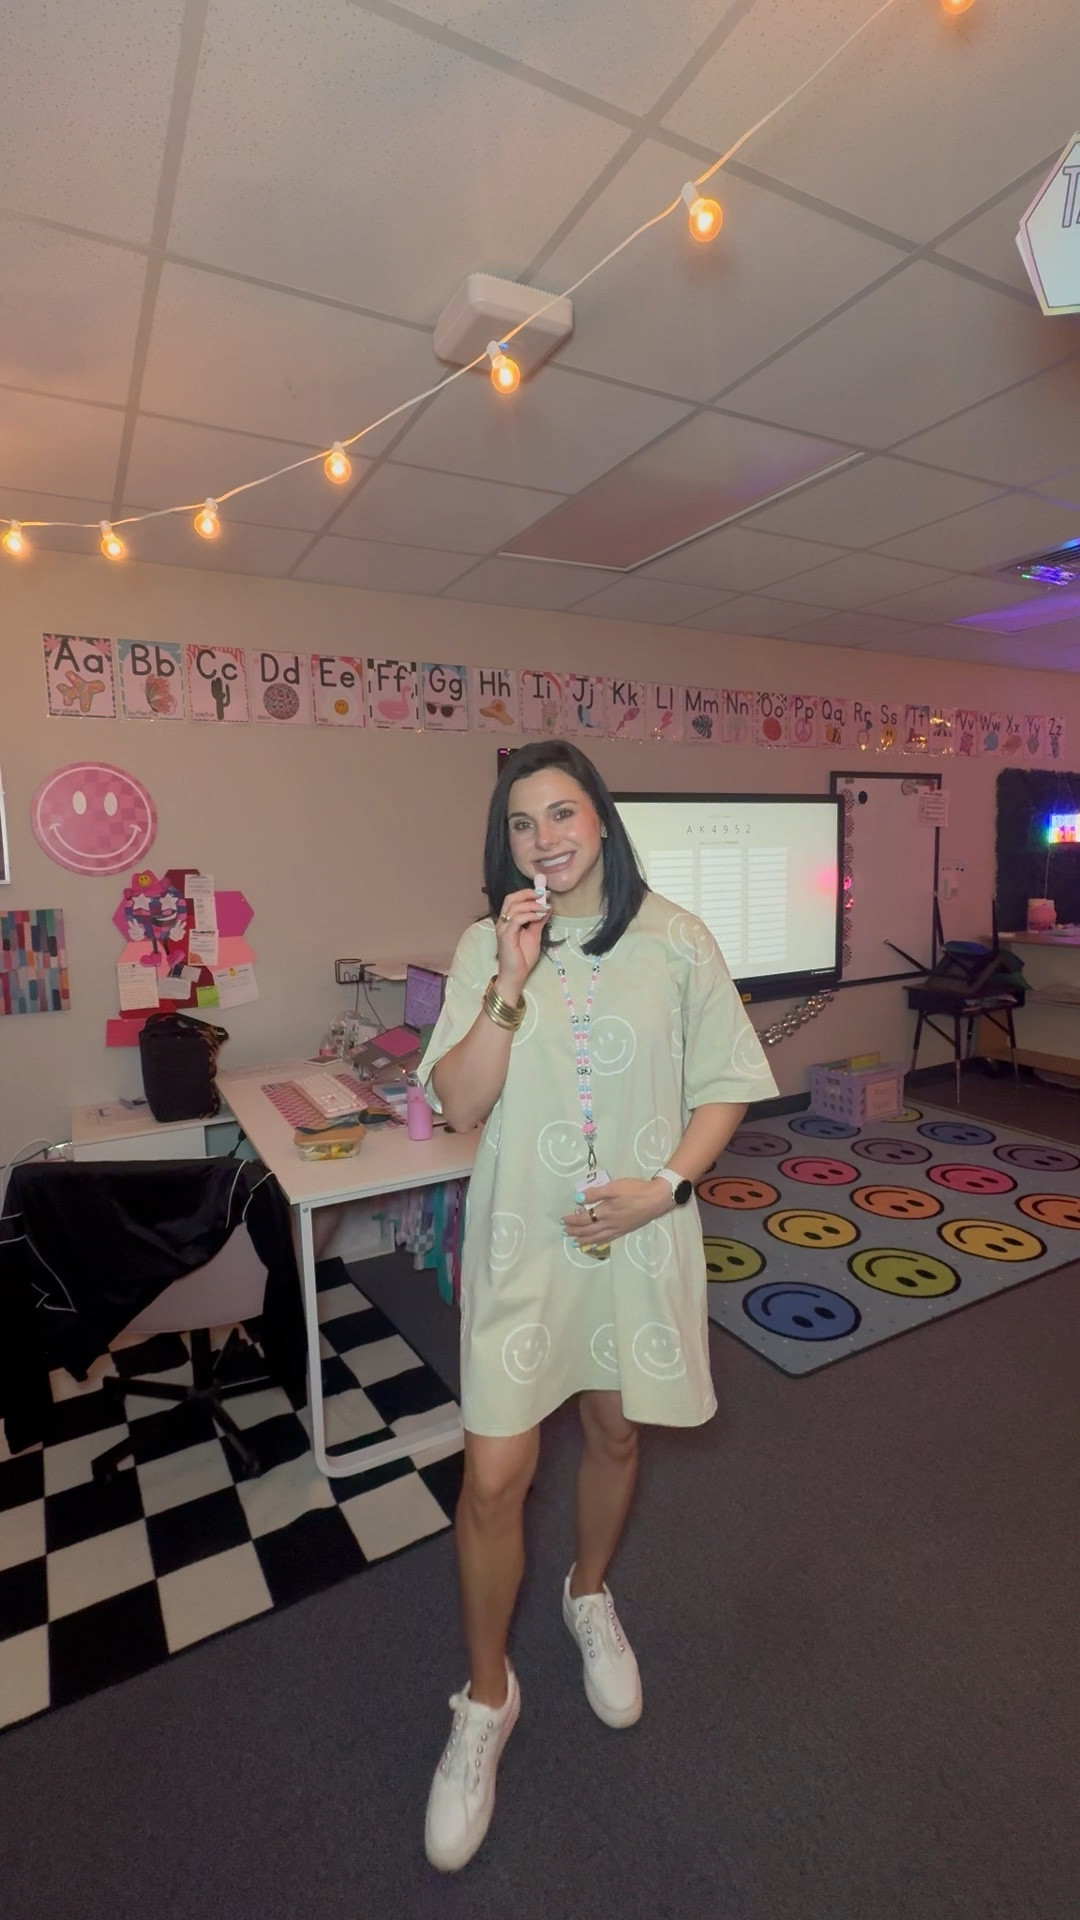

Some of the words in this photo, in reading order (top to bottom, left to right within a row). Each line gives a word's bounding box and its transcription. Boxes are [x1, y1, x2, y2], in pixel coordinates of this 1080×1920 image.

[1063, 165, 1080, 228] T
[53, 640, 104, 674] Aa
[131, 643, 175, 677] Bb
[196, 649, 238, 681] Cc
[260, 652, 300, 685] Dd
[319, 658, 355, 688] Ee
[377, 663, 409, 692] Ff
[428, 667, 463, 701] Gg
[479, 670, 511, 698] Hh
[532, 673, 551, 700] Ii
[572, 677, 595, 709] Jj
[612, 682, 638, 707] Kk
[656, 685, 674, 710] Ll
[685, 689, 719, 714] Mm
[726, 693, 749, 716] Nn
[760, 696, 784, 719] Oo
[794, 699, 814, 724] Pp
[822, 699, 845, 726] Qq
[854, 702, 872, 723] Rr
[880, 704, 897, 725] Ss
[910, 706, 925, 727] Tt
[959, 712, 974, 730] Vv
[979, 715, 1001, 732] Ww
[1006, 715, 1020, 734] Xx
[1049, 718, 1062, 736] Zz
[1027, 718, 1041, 739] Yy
